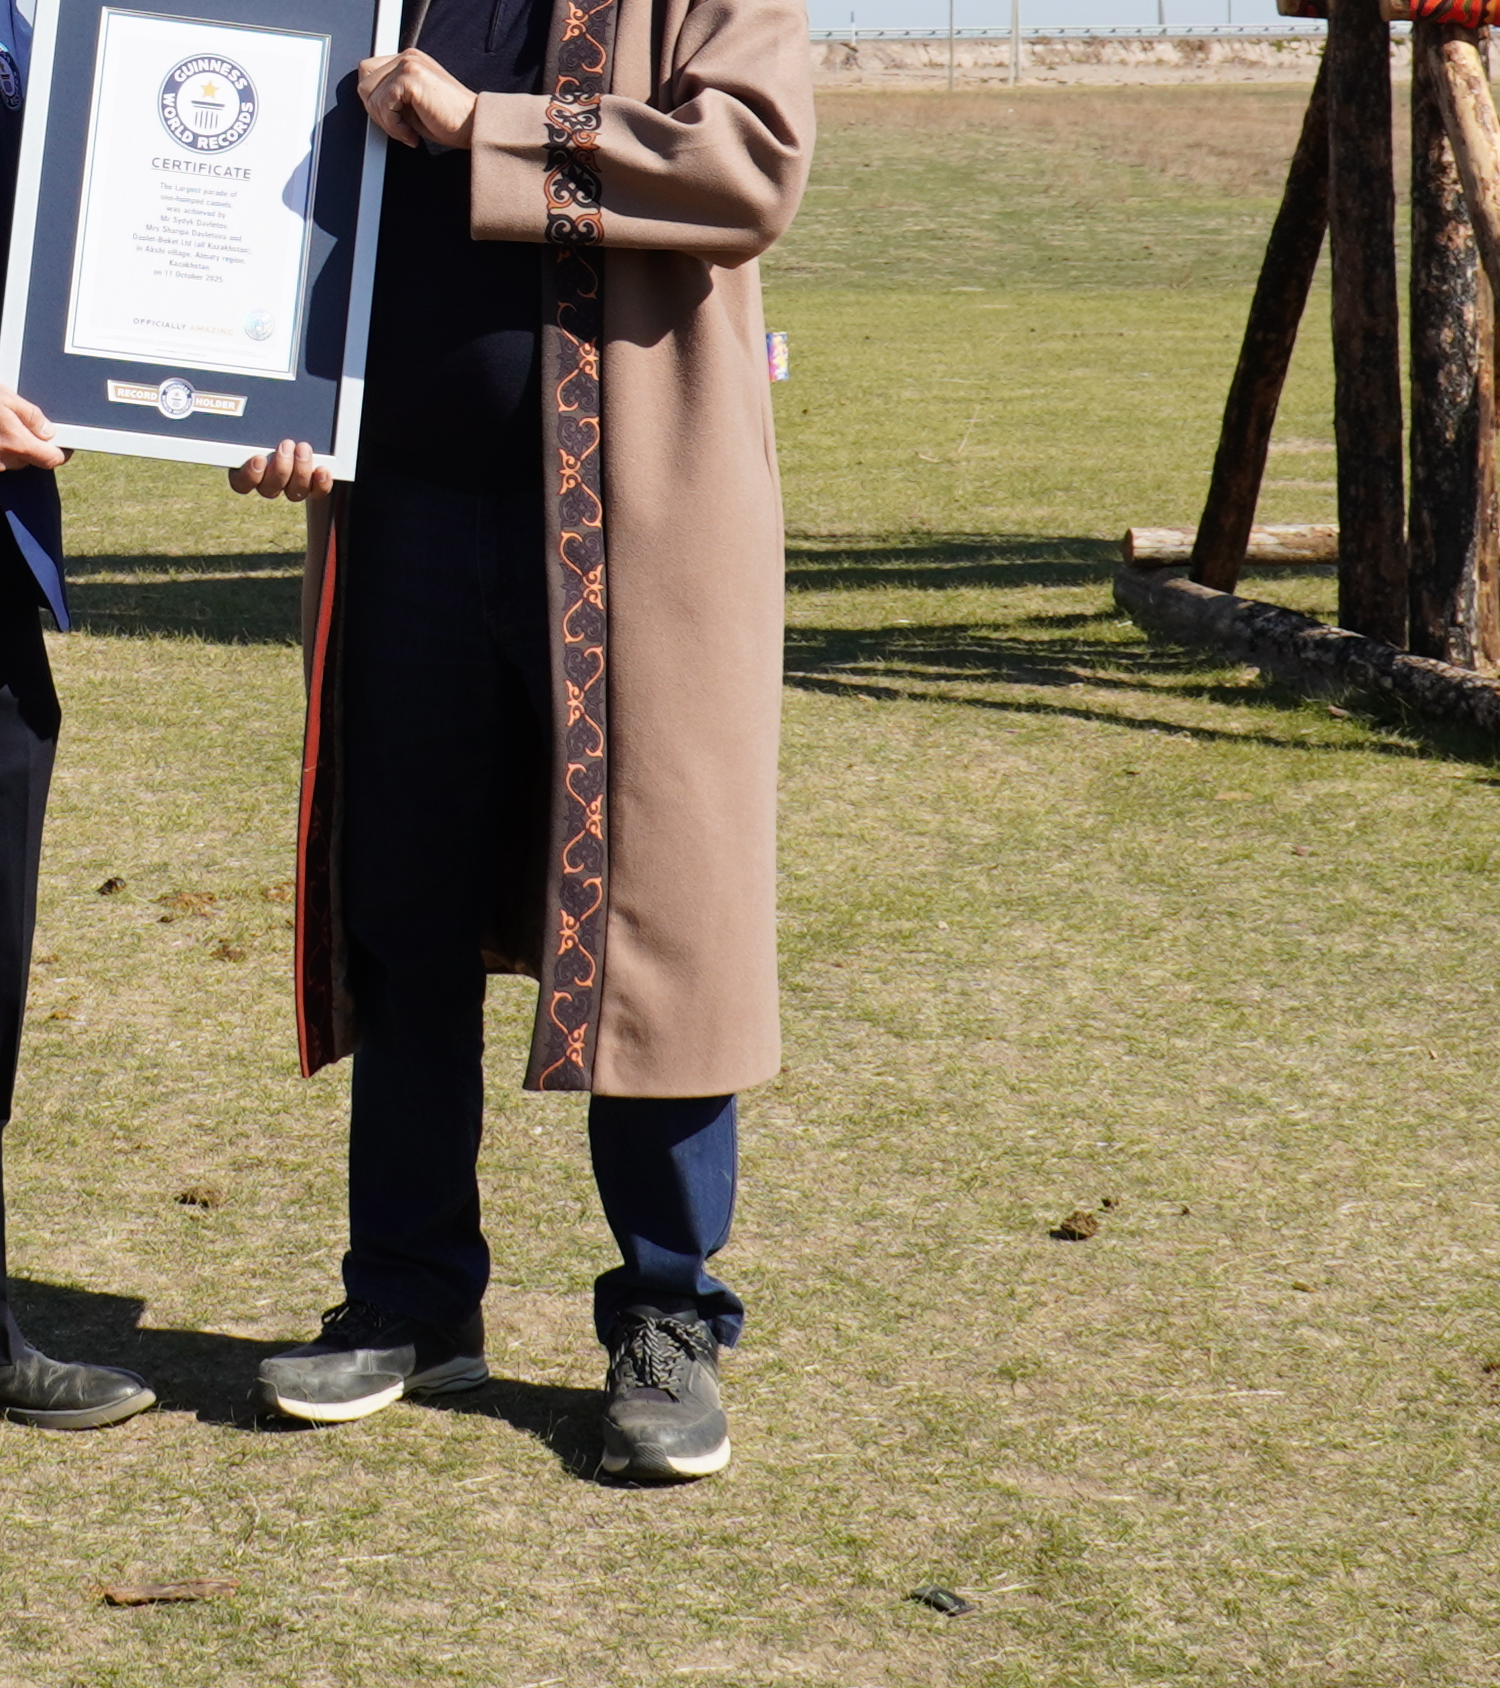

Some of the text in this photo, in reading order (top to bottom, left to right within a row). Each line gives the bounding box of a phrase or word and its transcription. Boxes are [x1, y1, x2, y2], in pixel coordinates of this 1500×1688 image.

[174, 59, 248, 90] GUINNESS
[162, 93, 253, 150] WORLD RECORDS
[151, 157, 251, 179] CERTIFICATE
[146, 224, 159, 232] Mrs
[133, 317, 235, 336] OFFICIALLY AMAZING
[117, 387, 158, 401] RECORD
[195, 396, 237, 410] HOLDER
